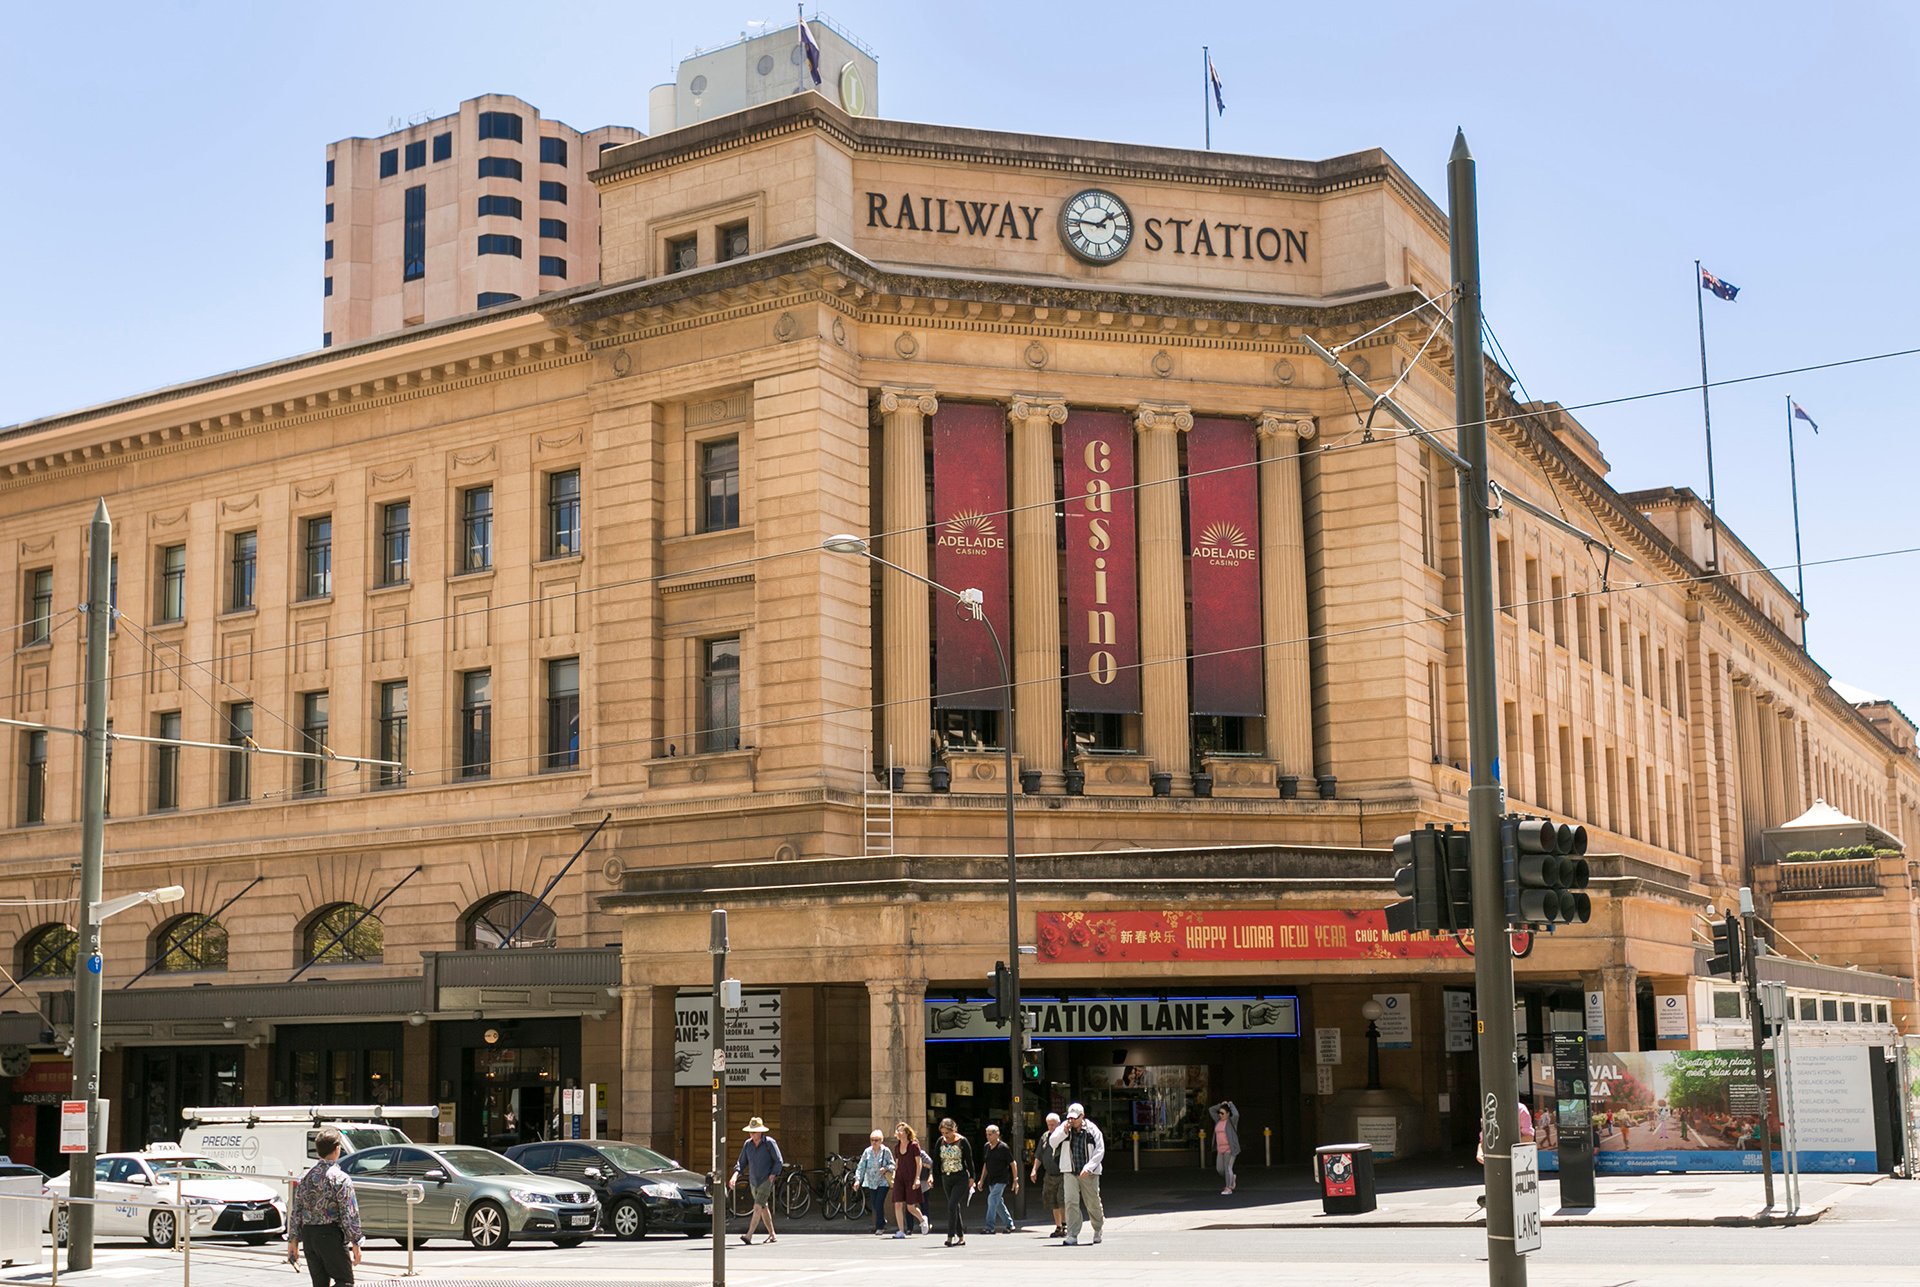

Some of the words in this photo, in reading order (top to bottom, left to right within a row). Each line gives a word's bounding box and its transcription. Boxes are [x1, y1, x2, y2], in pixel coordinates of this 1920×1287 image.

[866, 192, 1043, 241] RAILWAY
[1145, 218, 1308, 264] STATION
[937, 536, 1005, 549] ADELAIDE
[956, 548, 987, 556] CASINO
[1192, 547, 1256, 561] ADELAIDE
[1209, 559, 1240, 567] CASINO
[1120, 930, 1176, 944] 新春快乐
[1186, 926, 1227, 949] HAPPY
[1233, 925, 1274, 948] LUNAR
[1280, 925, 1308, 948] NEW
[1314, 925, 1347, 948] YEAR
[1355, 928, 1379, 943] CHÚC
[1140, 1003, 1209, 1032] LANE
[675, 1027, 699, 1042] ANE
[1714, 1057, 1728, 1067] the
[1728, 1057, 1752, 1068] place
[1732, 1067, 1750, 1076] and
[23, 1094, 57, 1103] ADELAIDE
[202, 1135, 242, 1146] PRECISE
[1517, 1212, 1538, 1240] LANE
